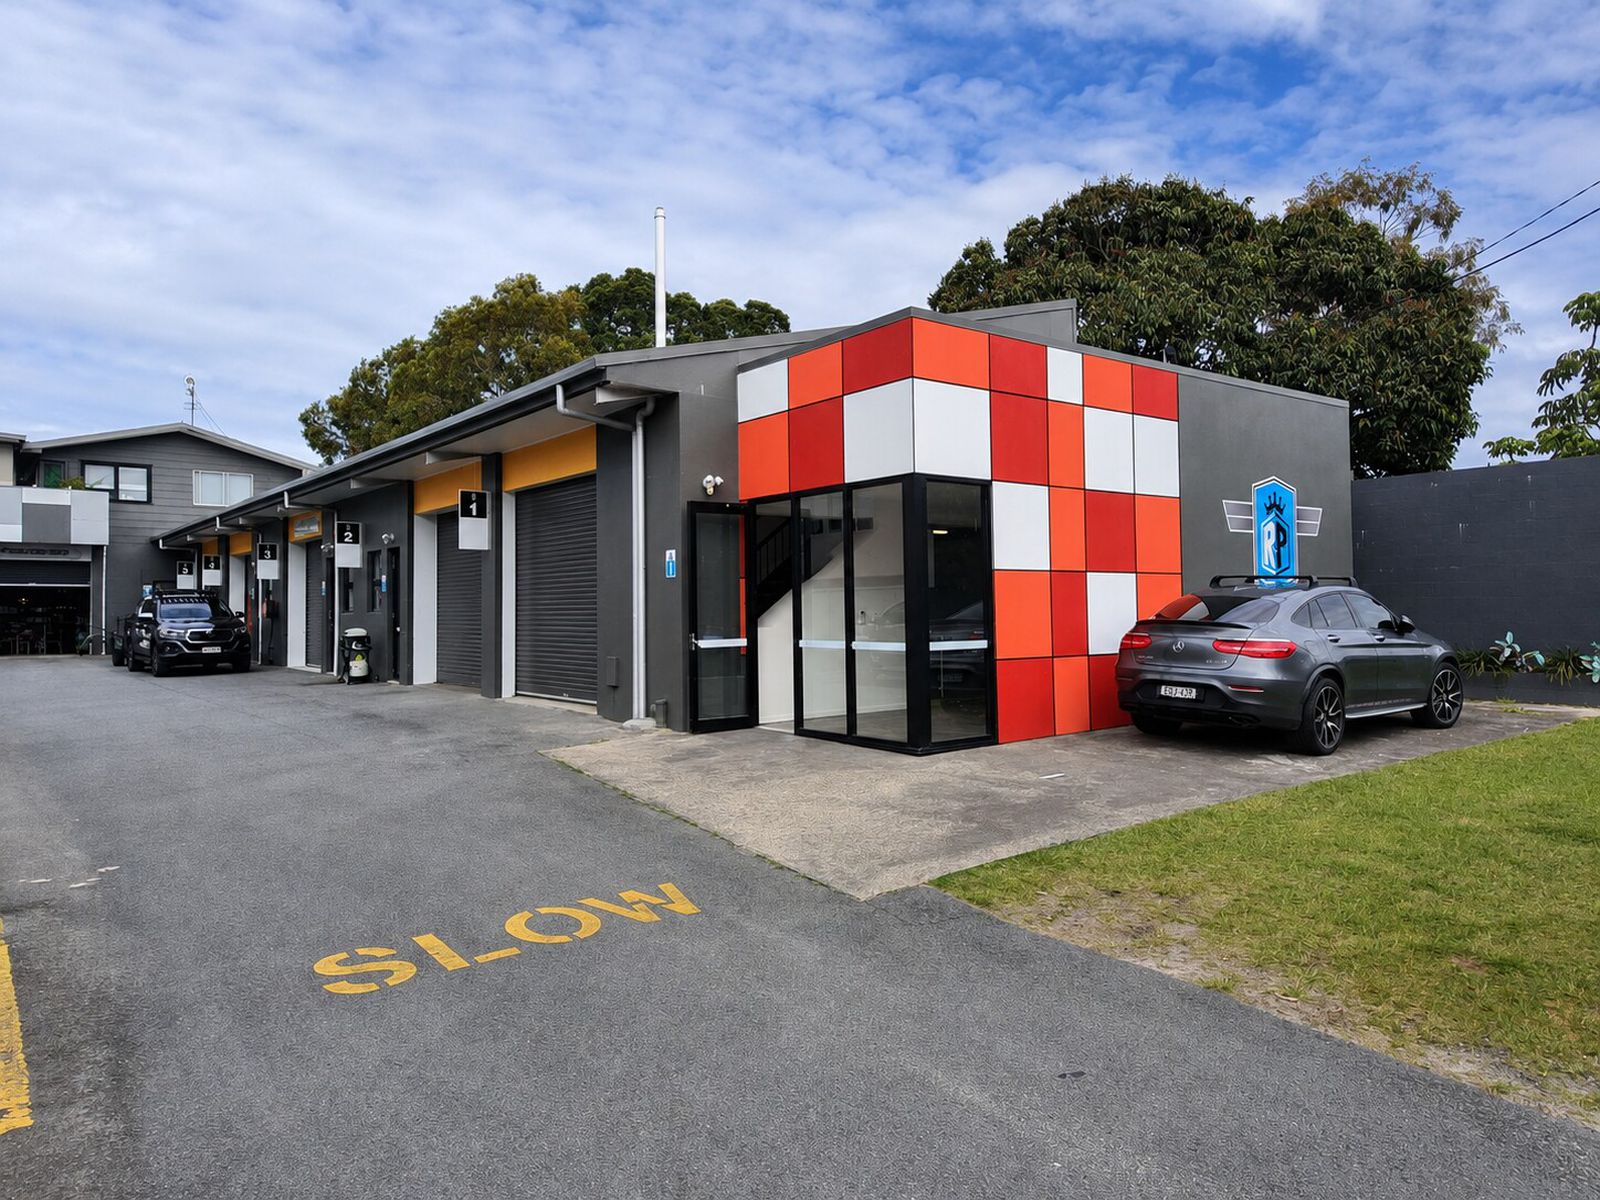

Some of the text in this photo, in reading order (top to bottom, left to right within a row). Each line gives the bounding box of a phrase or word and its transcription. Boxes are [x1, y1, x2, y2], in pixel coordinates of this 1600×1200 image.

[469, 502, 477, 516] 1
[344, 531, 353, 542] 2
[1263, 520, 1287, 569] RP
[264, 550, 271, 559] 3
[313, 883, 701, 994] SLOW
